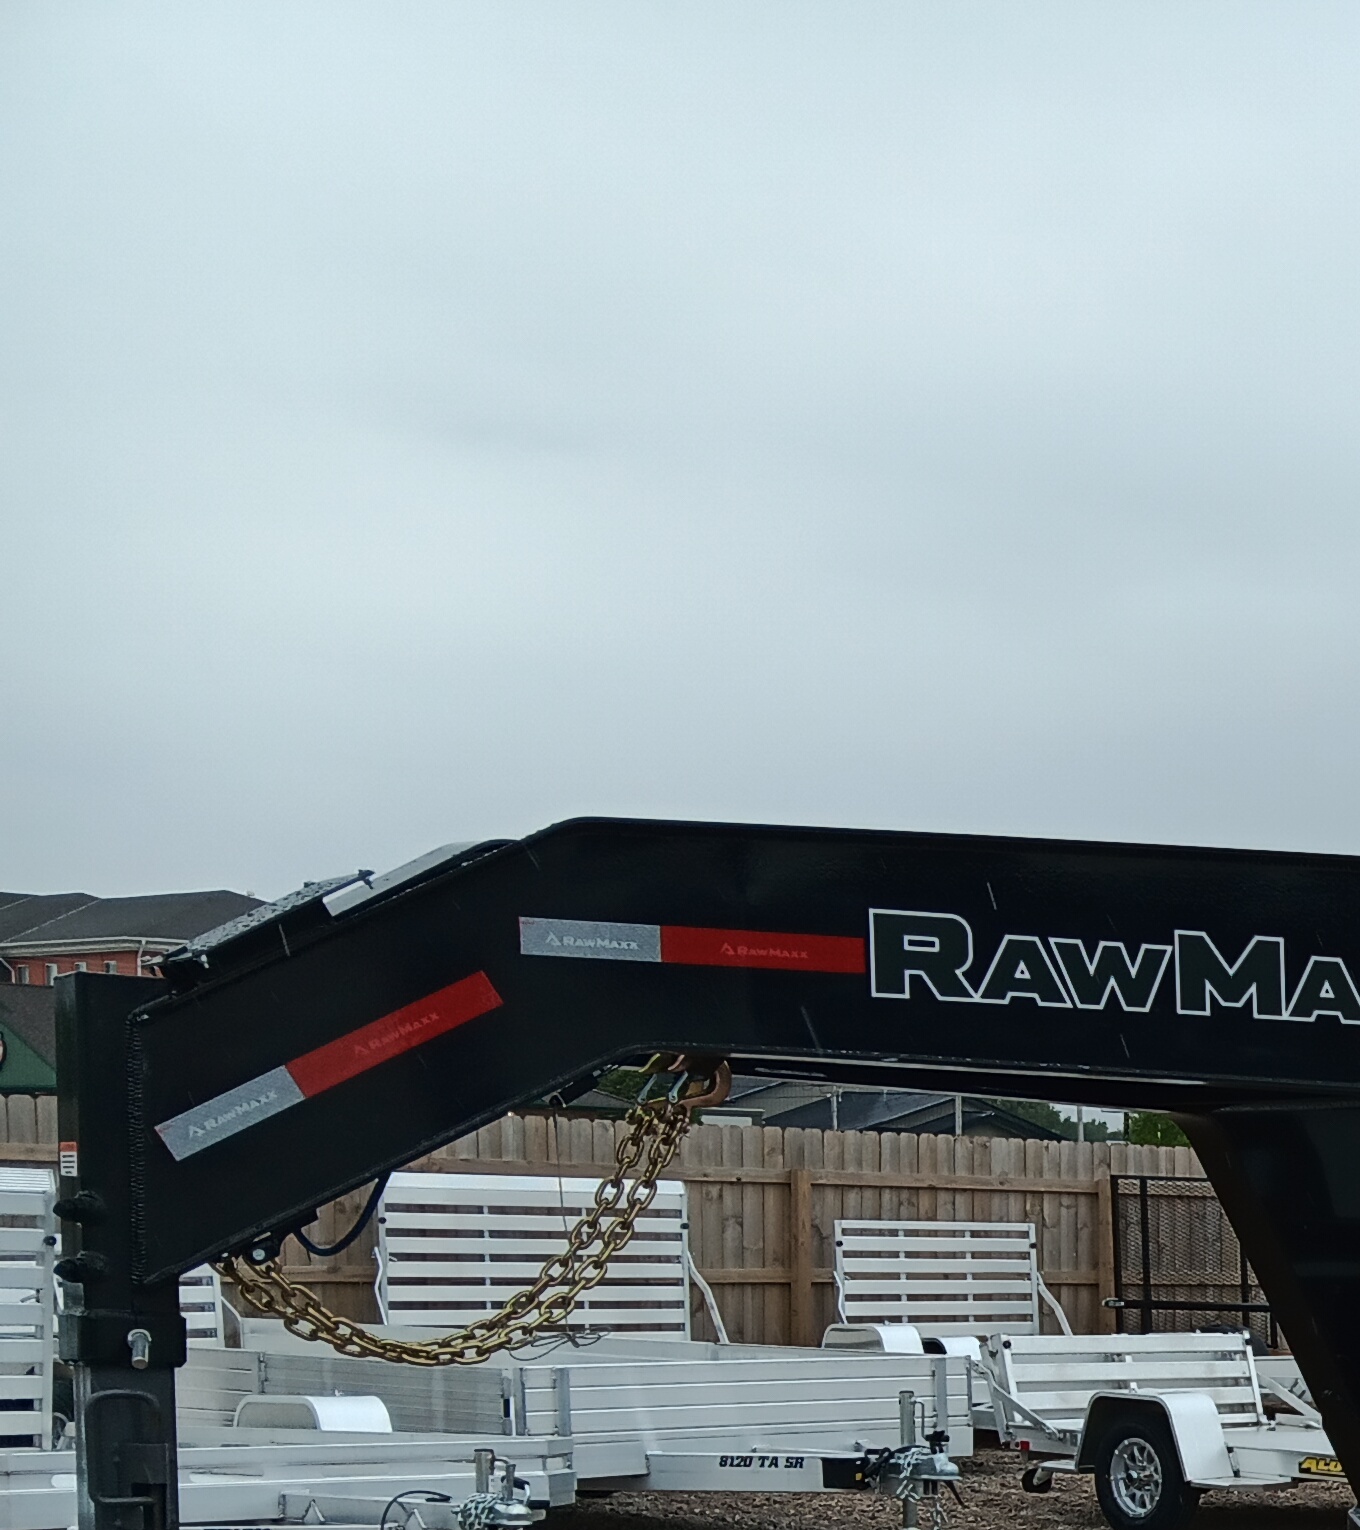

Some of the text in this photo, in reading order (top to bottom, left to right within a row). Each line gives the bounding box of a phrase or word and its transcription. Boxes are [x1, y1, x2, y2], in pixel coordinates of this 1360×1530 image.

[563, 935, 639, 951] RAWMAXX
[719, 1455, 805, 1469] 8120 TA SR
[1299, 1457, 1343, 1472] ALU
